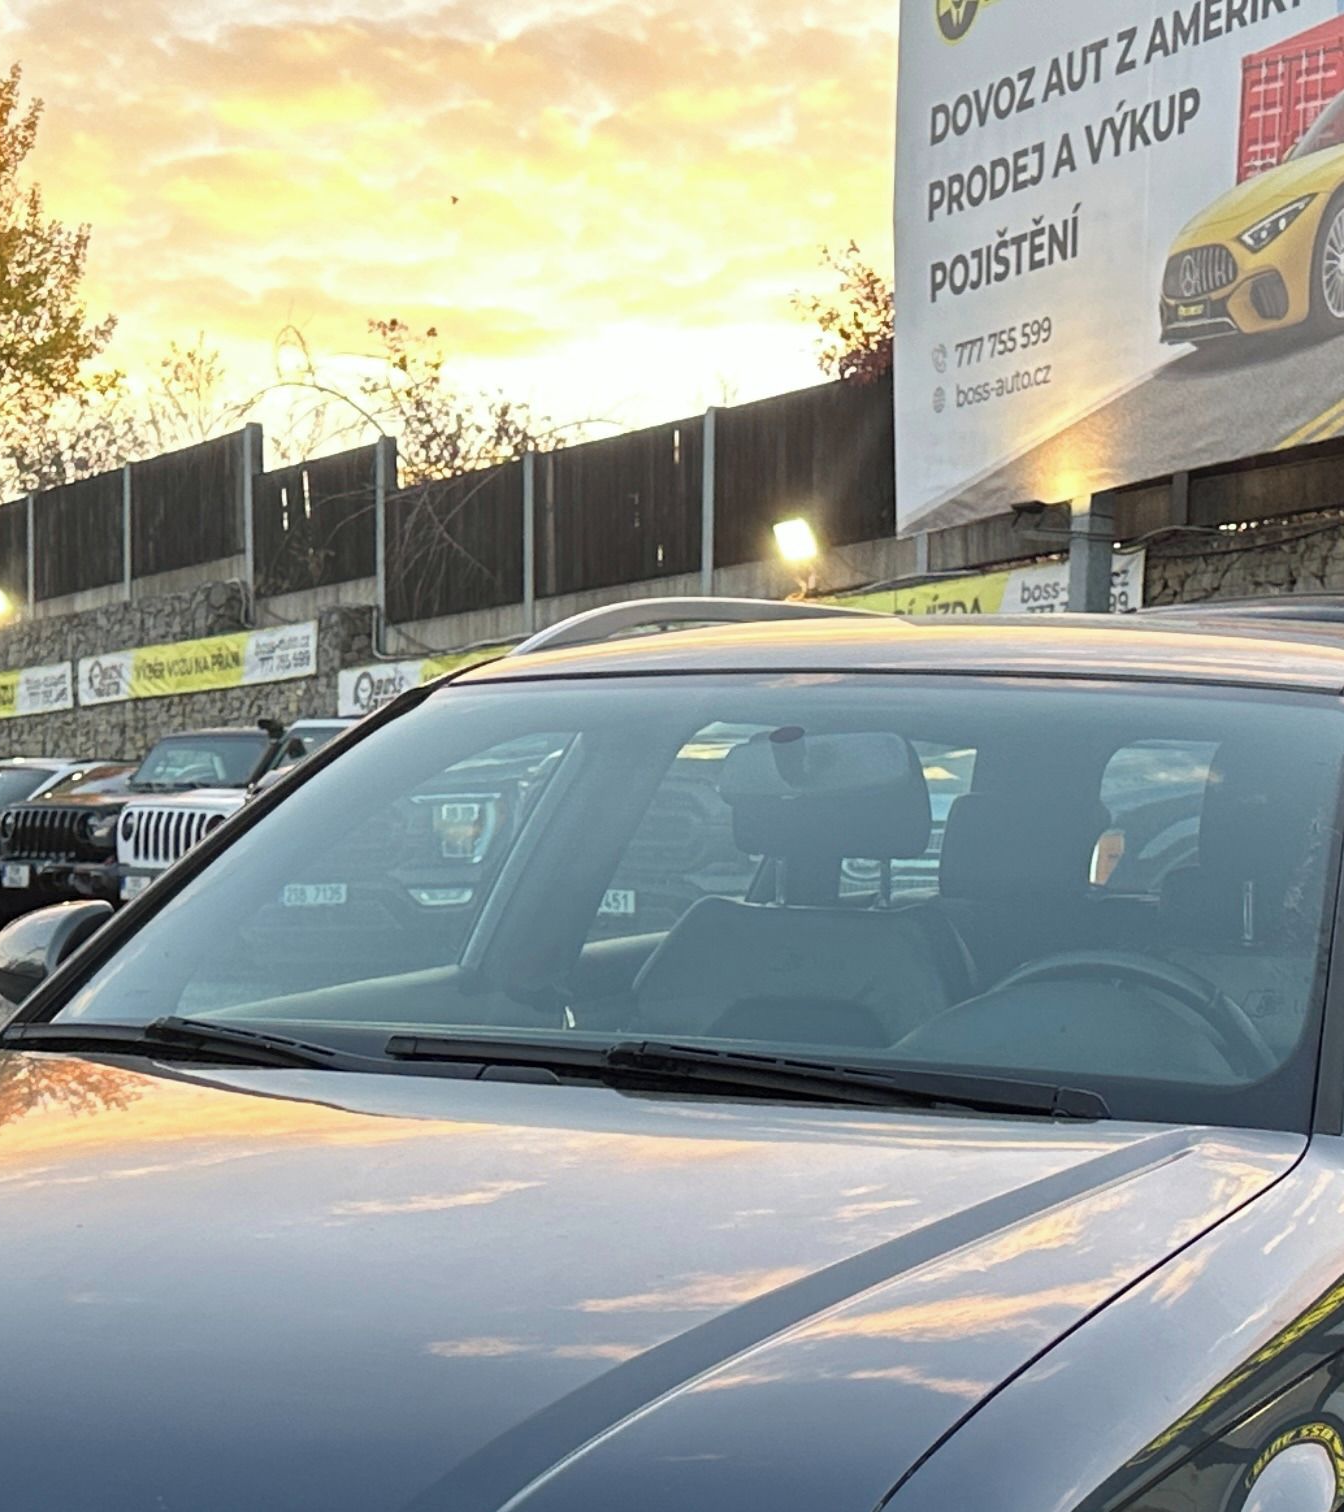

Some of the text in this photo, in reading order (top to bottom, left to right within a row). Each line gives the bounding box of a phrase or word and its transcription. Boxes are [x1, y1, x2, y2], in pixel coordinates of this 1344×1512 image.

[930, 0, 1300, 147] DOVOZ AUT Z AMERI
[928, 87, 1201, 222] PRODEJ A VÝKUP
[930, 202, 1082, 304] POJIŠTĚNÍ
[955, 316, 1052, 368] 777 755 599
[956, 365, 1052, 408] boss-auto.cz
